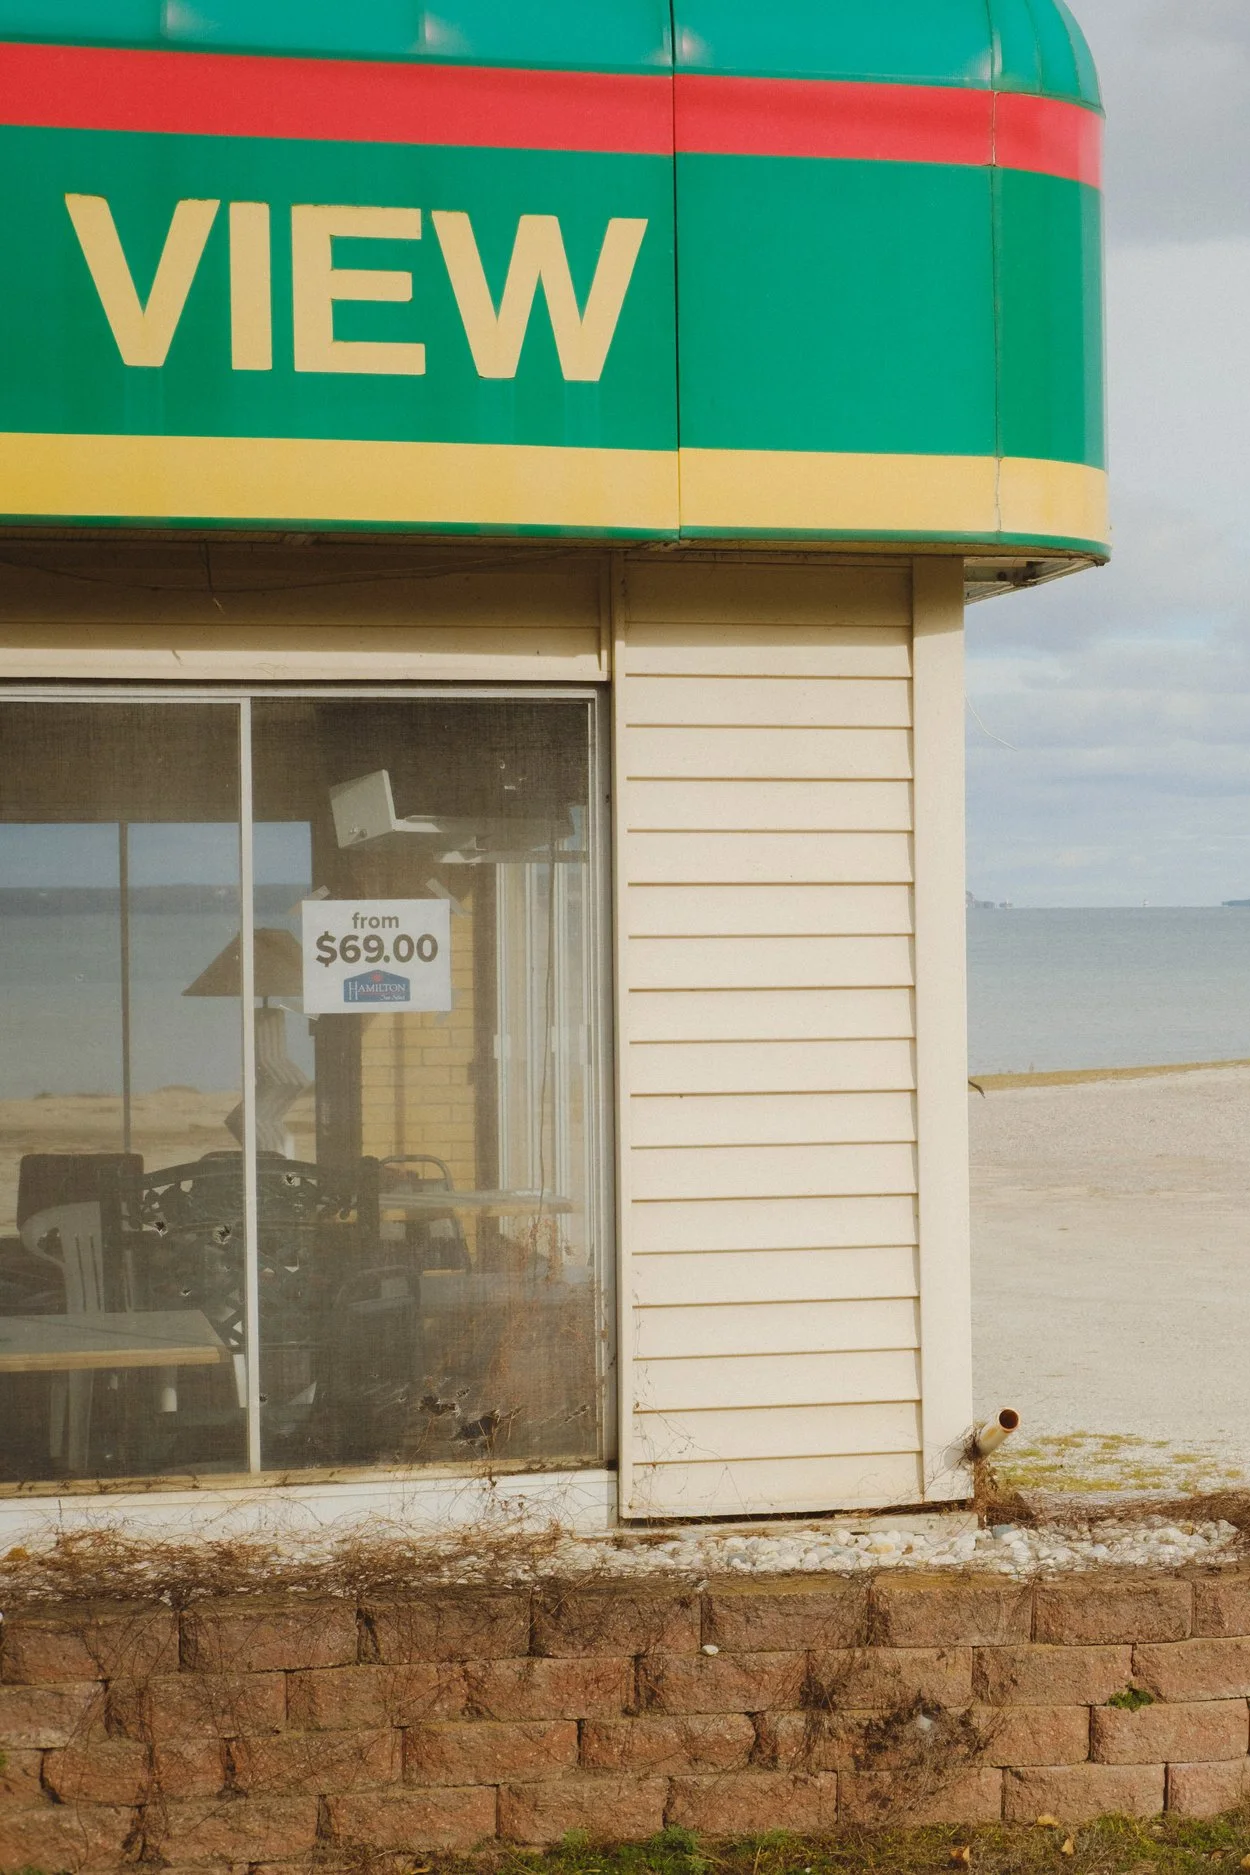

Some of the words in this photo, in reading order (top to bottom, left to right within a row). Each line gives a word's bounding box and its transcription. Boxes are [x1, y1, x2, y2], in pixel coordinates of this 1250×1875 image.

[65, 193, 648, 381] VIEW
[352, 912, 399, 929] from
[316, 931, 438, 967] $69.00
[348, 980, 406, 1000] HAMILTON
